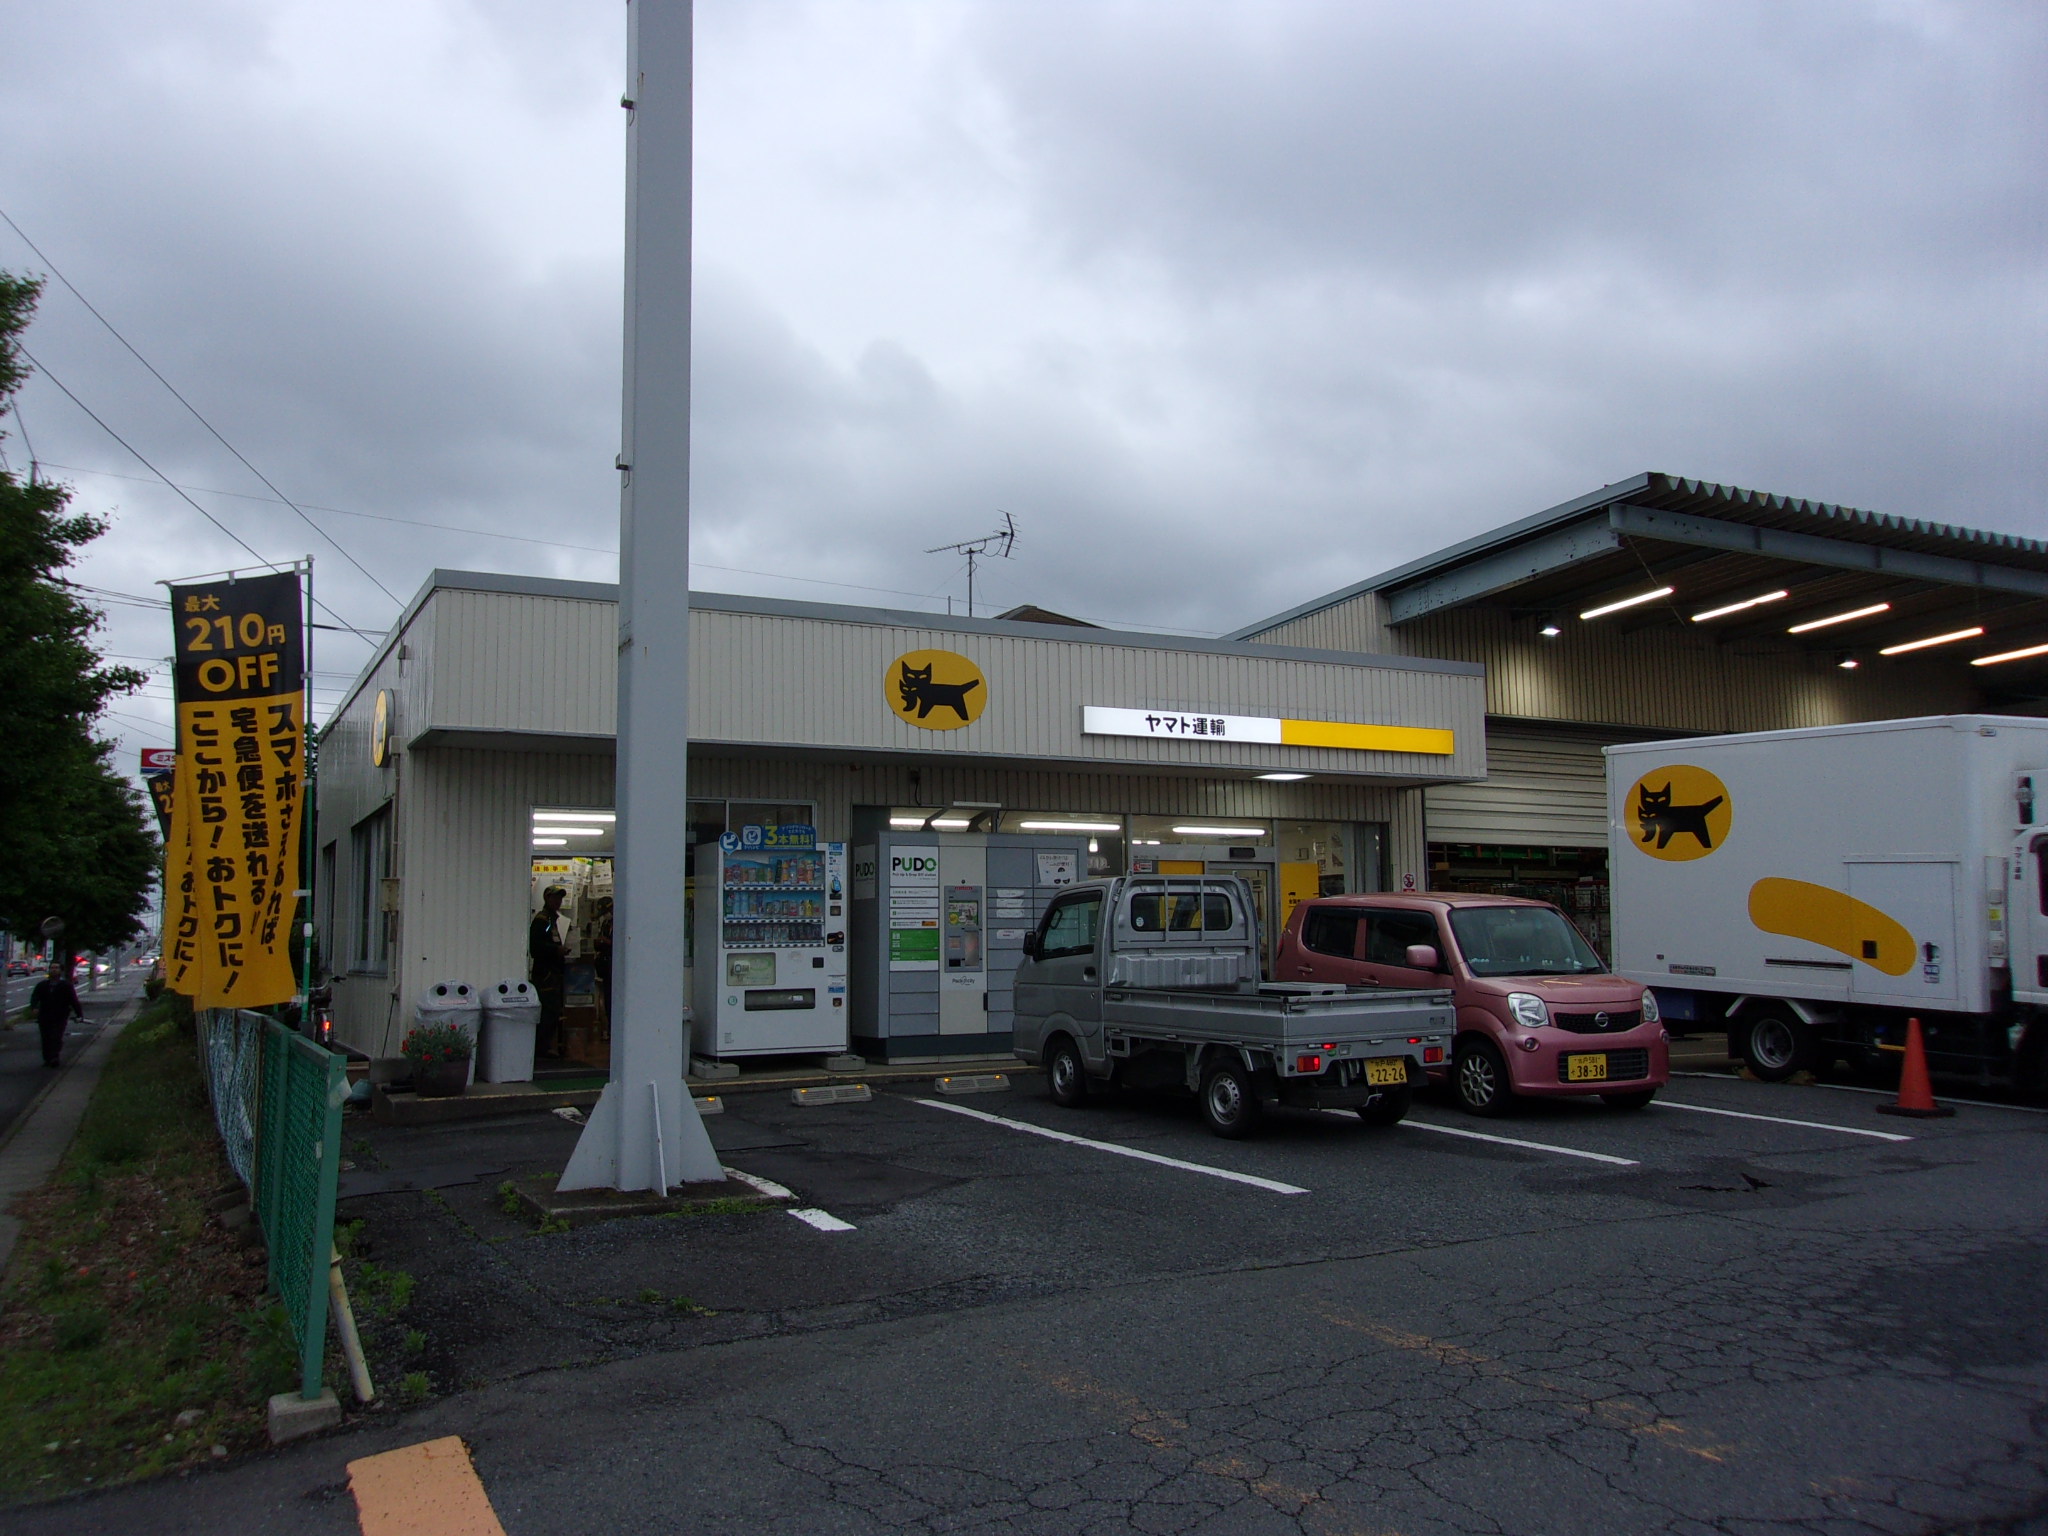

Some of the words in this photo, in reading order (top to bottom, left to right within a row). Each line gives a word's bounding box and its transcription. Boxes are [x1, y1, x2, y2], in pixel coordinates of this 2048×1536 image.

[185, 594, 220, 612] 最大
[186, 613, 286, 652] 210円
[199, 653, 279, 693] OFF
[1145, 714, 1225, 736] ヤマト運輸
[855, 862, 875, 877] PUDO
[892, 857, 937, 872] PUDO
